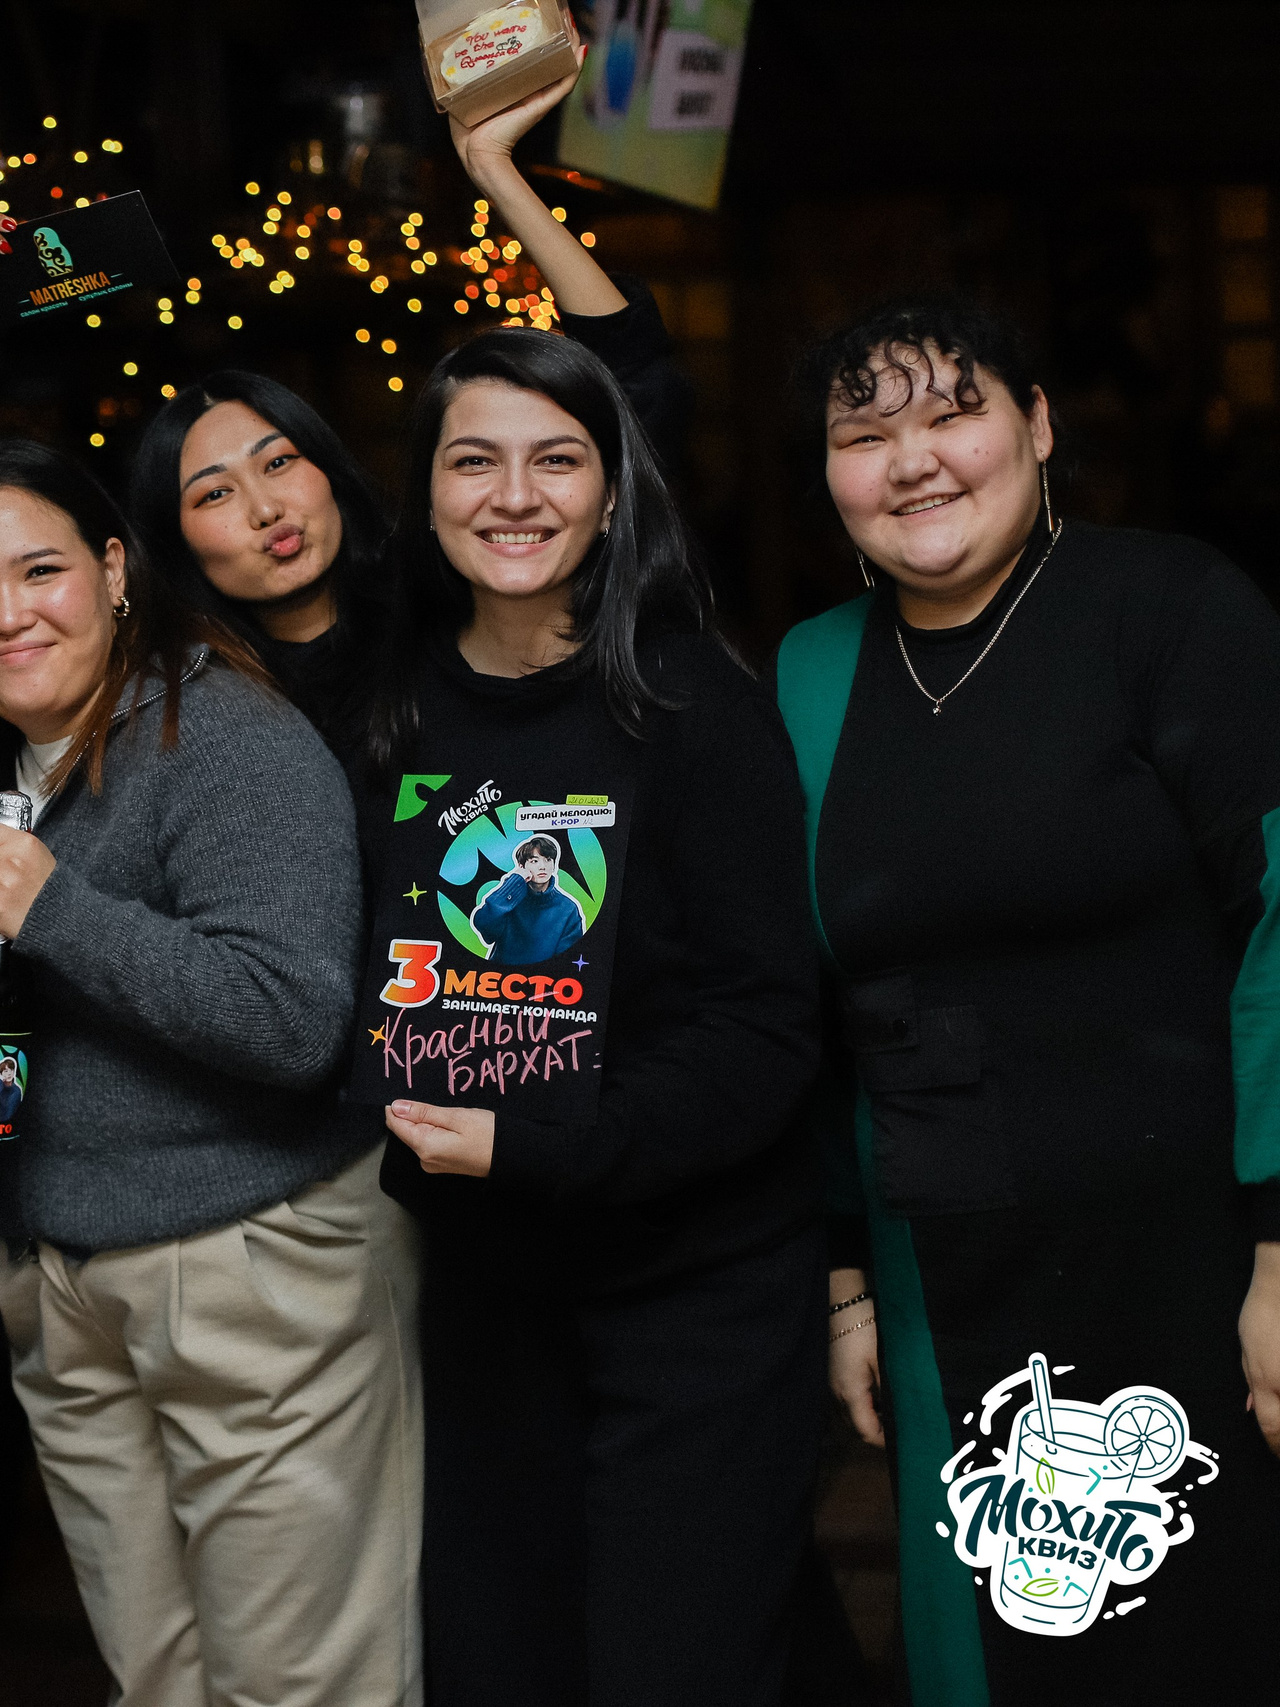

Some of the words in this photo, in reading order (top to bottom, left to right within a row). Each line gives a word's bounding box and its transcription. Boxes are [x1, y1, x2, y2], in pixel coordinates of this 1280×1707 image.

[455, 49, 468, 59] be
[30, 271, 111, 306] MATRËSHKA
[20, 309, 40, 318] салон
[40, 301, 69, 313] красоты
[462, 804, 489, 824] КВИЗ
[520, 809, 558, 821] УГАДАЙ
[379, 939, 442, 1008] 3
[443, 969, 583, 1005] МЕСТО
[442, 999, 520, 1016] ЗАНИМАЕТ
[523, 1006, 598, 1023] КОМАНДА
